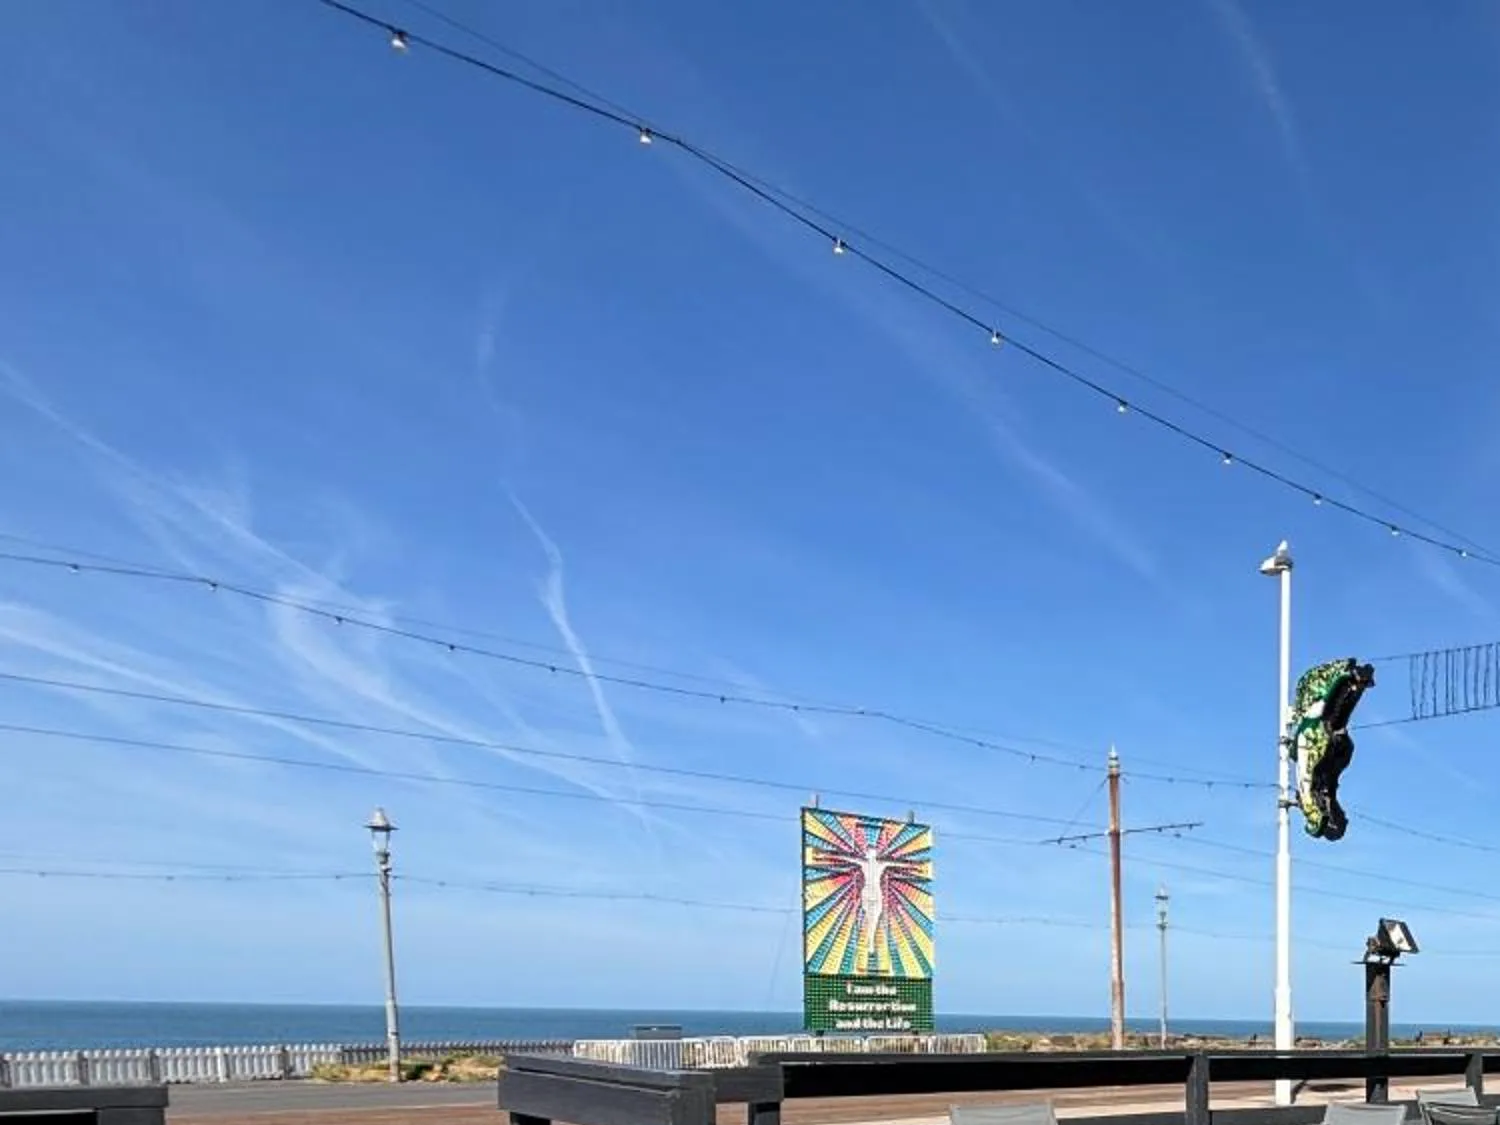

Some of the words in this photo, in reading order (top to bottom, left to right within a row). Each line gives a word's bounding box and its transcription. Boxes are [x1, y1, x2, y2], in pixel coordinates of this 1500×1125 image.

[854, 986, 873, 994] am
[876, 984, 897, 994] the
[829, 1000, 917, 1011] Resurrection
[836, 1018, 861, 1029] and
[863, 1018, 884, 1029] the
[885, 1017, 912, 1029] Life
